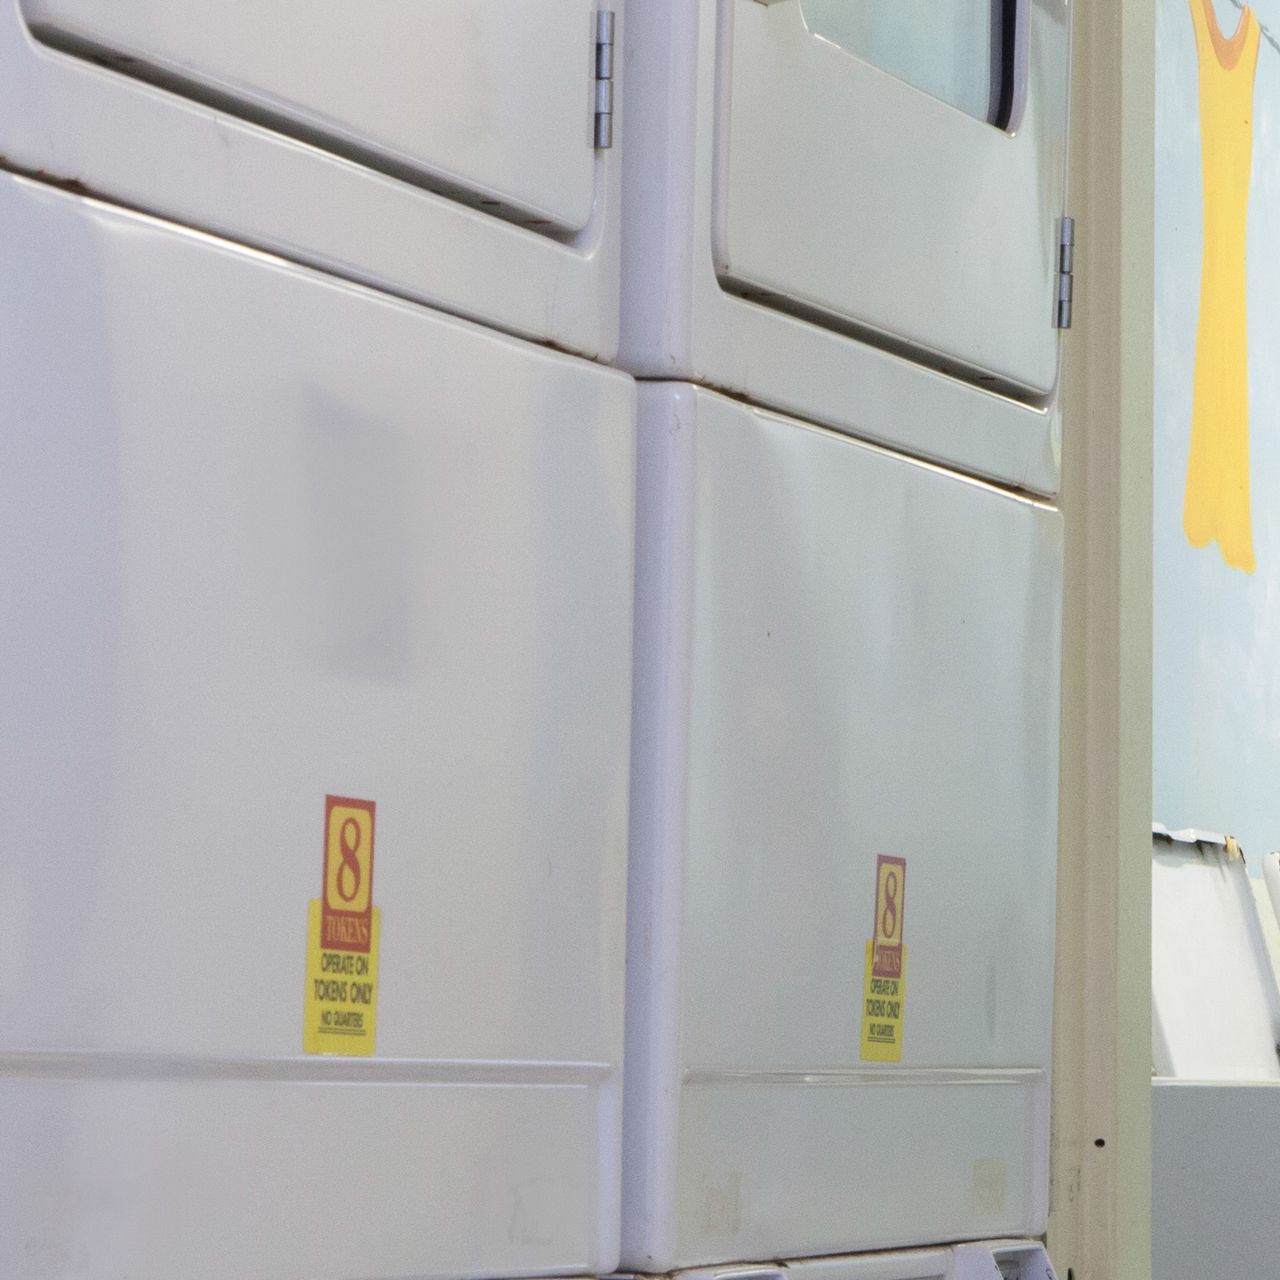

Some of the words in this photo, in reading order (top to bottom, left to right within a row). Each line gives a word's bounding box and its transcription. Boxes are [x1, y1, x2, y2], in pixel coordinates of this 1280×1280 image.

[337, 817, 361, 902] 8
[883, 872, 897, 938] 8
[327, 915, 369, 944] TOKENS
[321, 953, 354, 975] OPERATE
[356, 956, 369, 976] ON
[314, 979, 348, 1002] TOKENS
[351, 981, 372, 1004] ONLY
[890, 979, 898, 996] ON
[321, 1010, 332, 1026] NO
